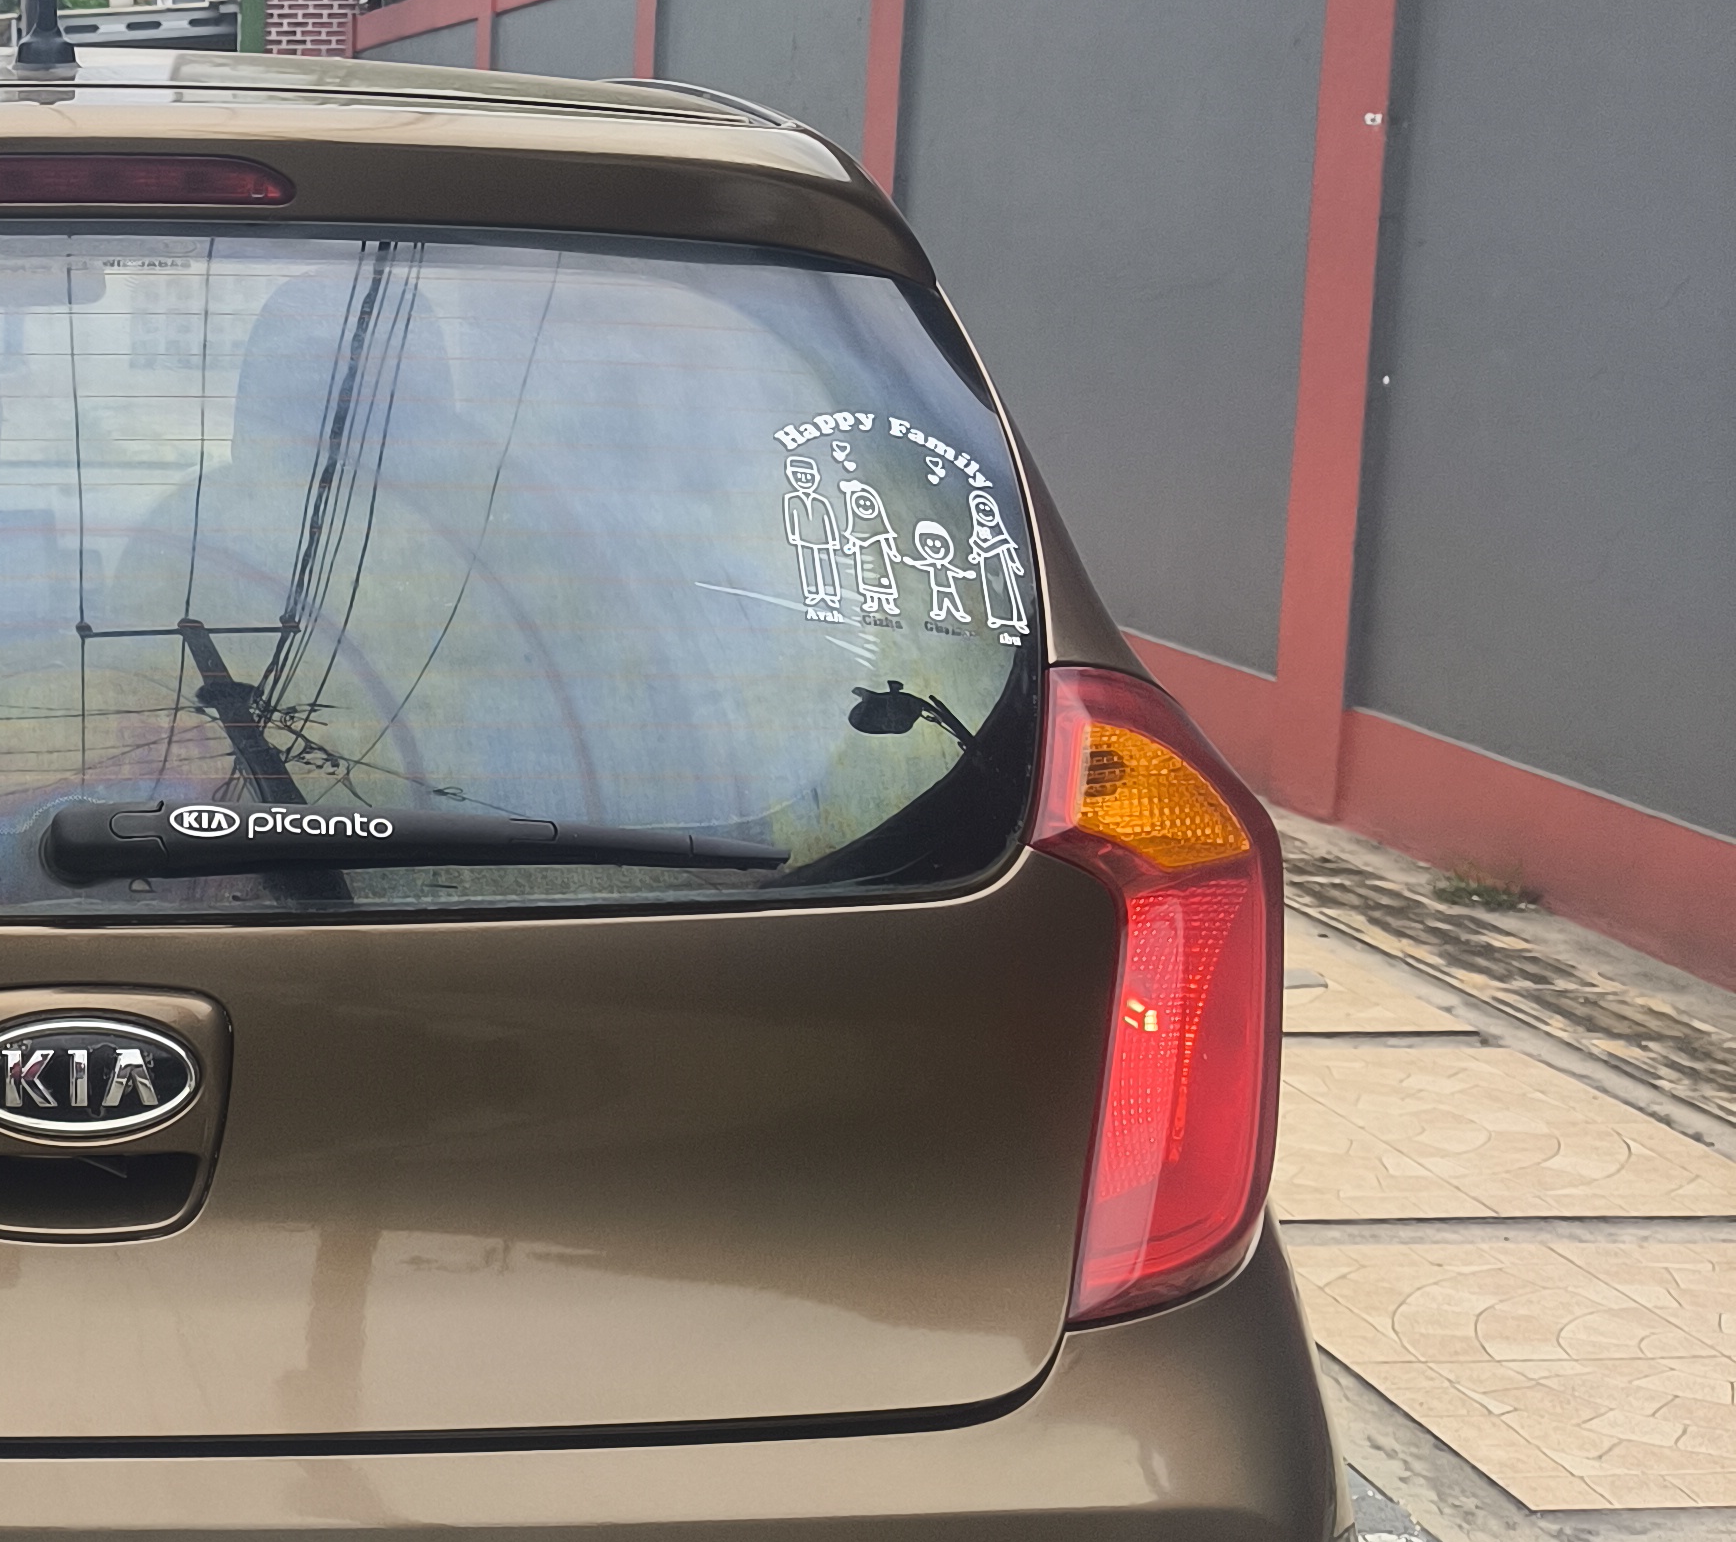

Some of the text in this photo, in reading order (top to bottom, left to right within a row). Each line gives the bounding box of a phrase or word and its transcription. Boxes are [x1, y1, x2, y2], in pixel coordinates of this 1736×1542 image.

[774, 412, 993, 487] Happy Family
[248, 807, 393, 838] picanto
[1, 1048, 159, 1107] KIA
